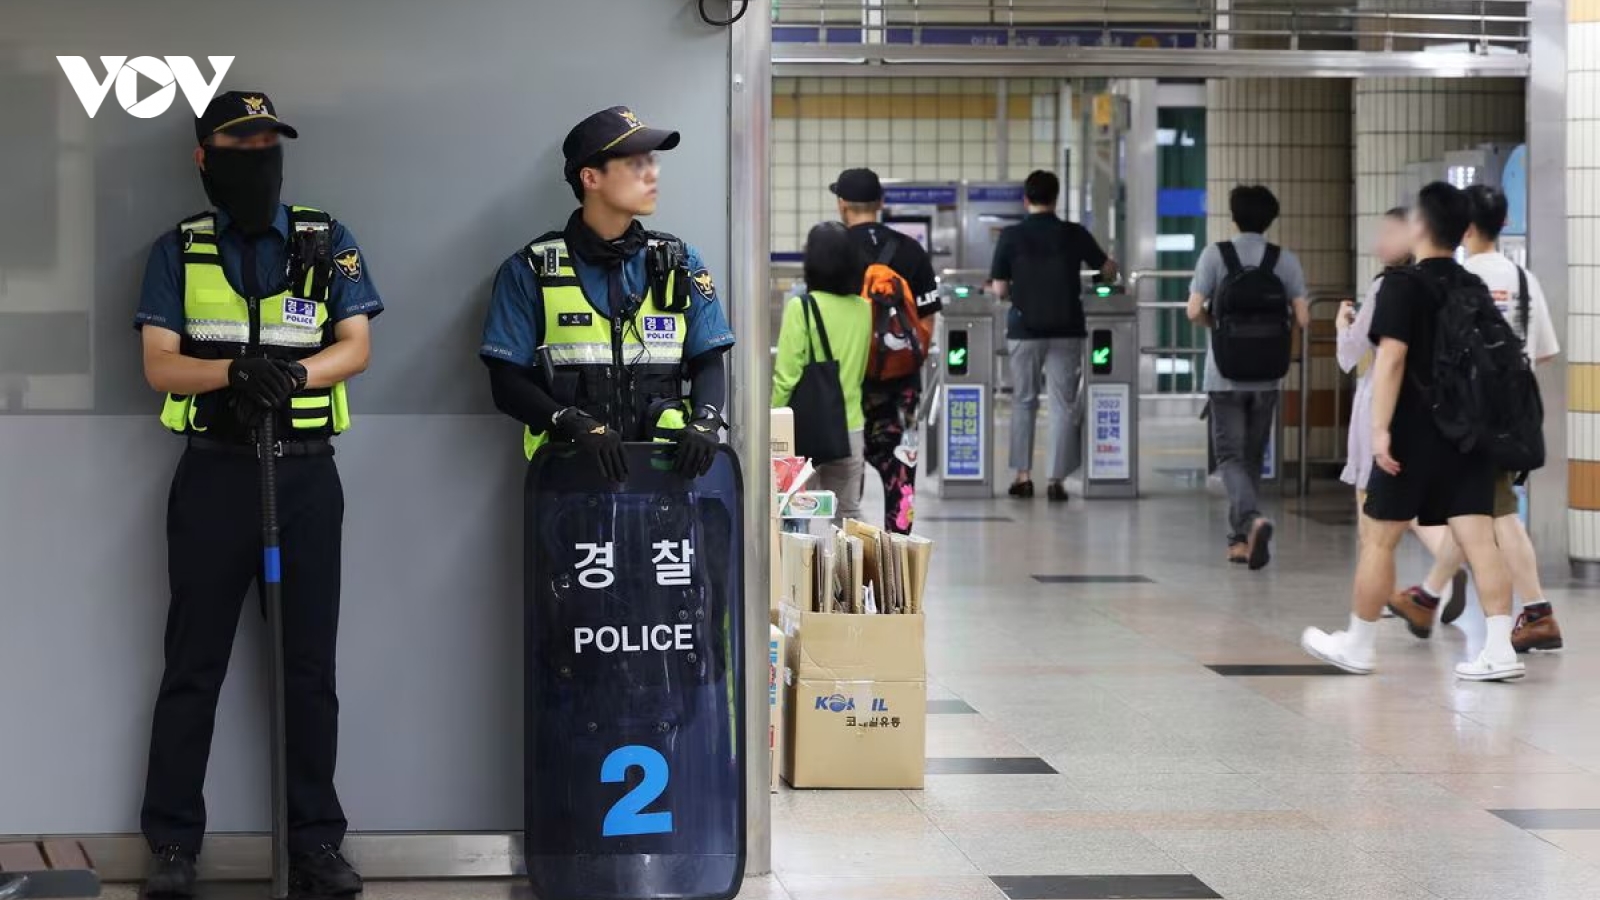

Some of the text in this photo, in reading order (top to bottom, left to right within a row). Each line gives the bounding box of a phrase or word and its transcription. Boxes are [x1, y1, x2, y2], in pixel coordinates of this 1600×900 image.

[286, 314, 313, 324] POLICE
[574, 624, 694, 654] POLICE
[600, 745, 673, 837] 2
